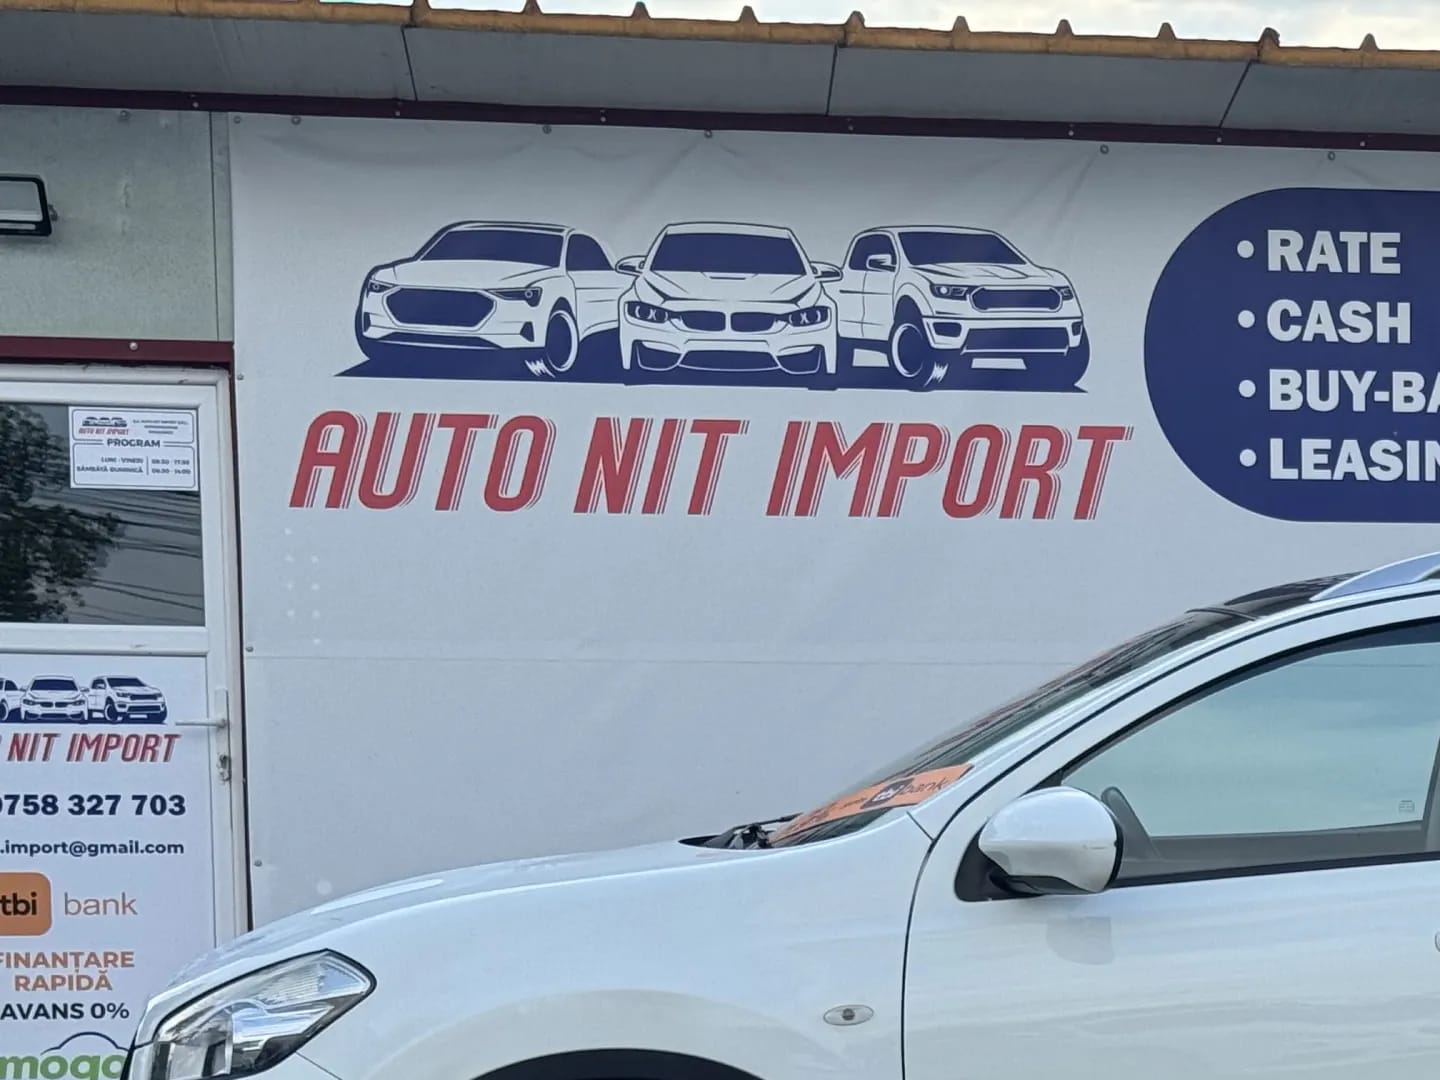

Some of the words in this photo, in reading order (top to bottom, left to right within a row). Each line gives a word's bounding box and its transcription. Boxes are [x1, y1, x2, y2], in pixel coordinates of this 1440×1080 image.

[1267, 229, 1401, 275] RATE
[1266, 298, 1411, 344] CASH
[106, 438, 161, 448] PROGRAM
[288, 410, 558, 513] AUTO
[572, 417, 749, 517] NIT
[765, 420, 1133, 521] IMPORT
[7, 733, 61, 761] NIT
[66, 733, 182, 763] IMPORT
[0, 794, 59, 816] 758
[67, 794, 122, 816] 327
[131, 794, 187, 816] 703
[0, 892, 38, 917] tbi
[64, 891, 138, 916] bank
[14, 970, 113, 991] RAPIDĂ
[0, 1002, 85, 1020] AVANS
[90, 1002, 130, 1020] 0%
